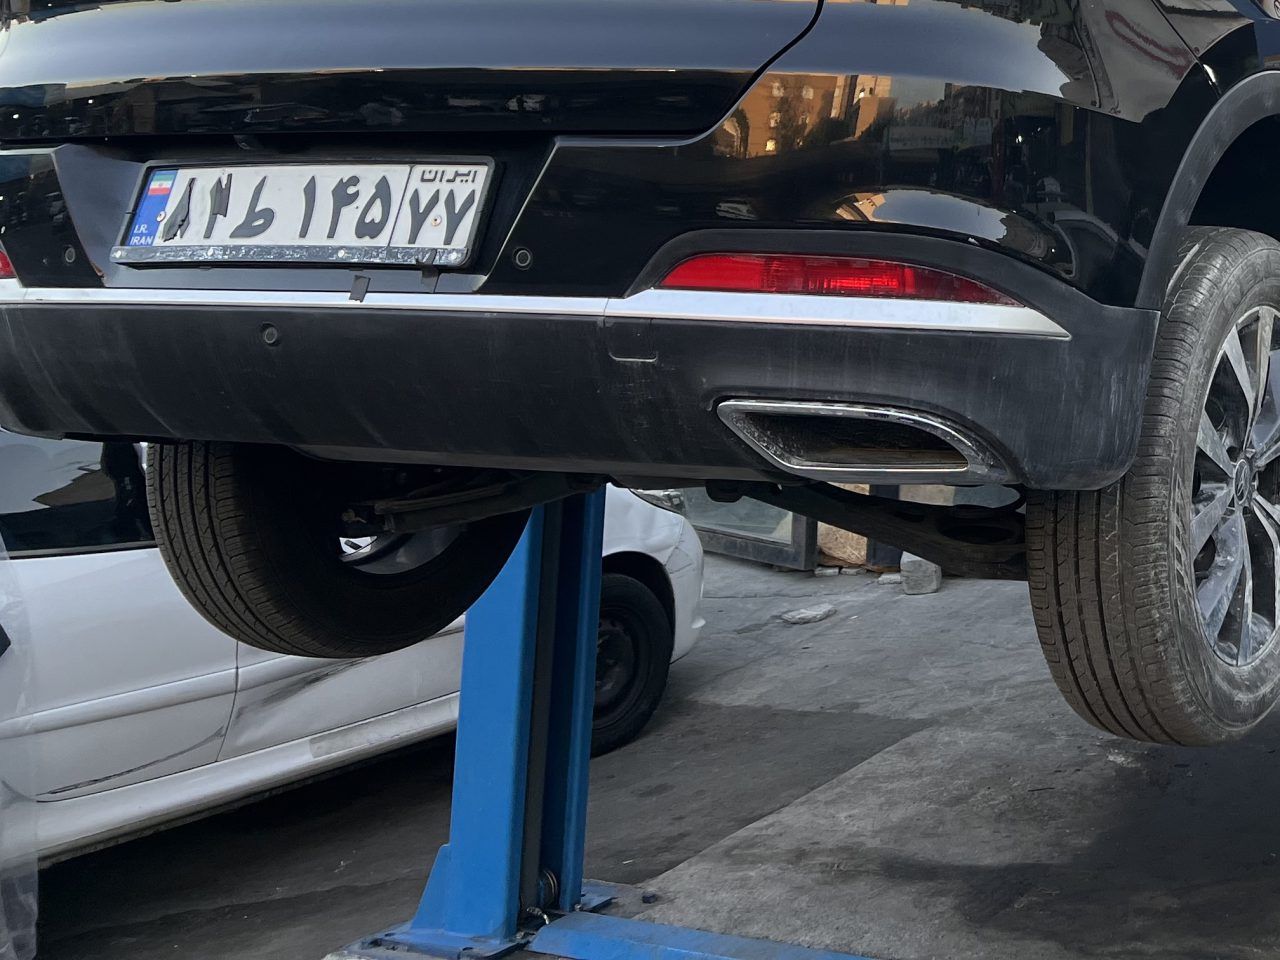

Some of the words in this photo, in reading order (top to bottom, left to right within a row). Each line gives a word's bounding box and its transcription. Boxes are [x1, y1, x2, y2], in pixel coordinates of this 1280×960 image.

[420, 170, 478, 183] ایران
[407, 187, 476, 245] ۷۷
[130, 236, 154, 246] IRAN
